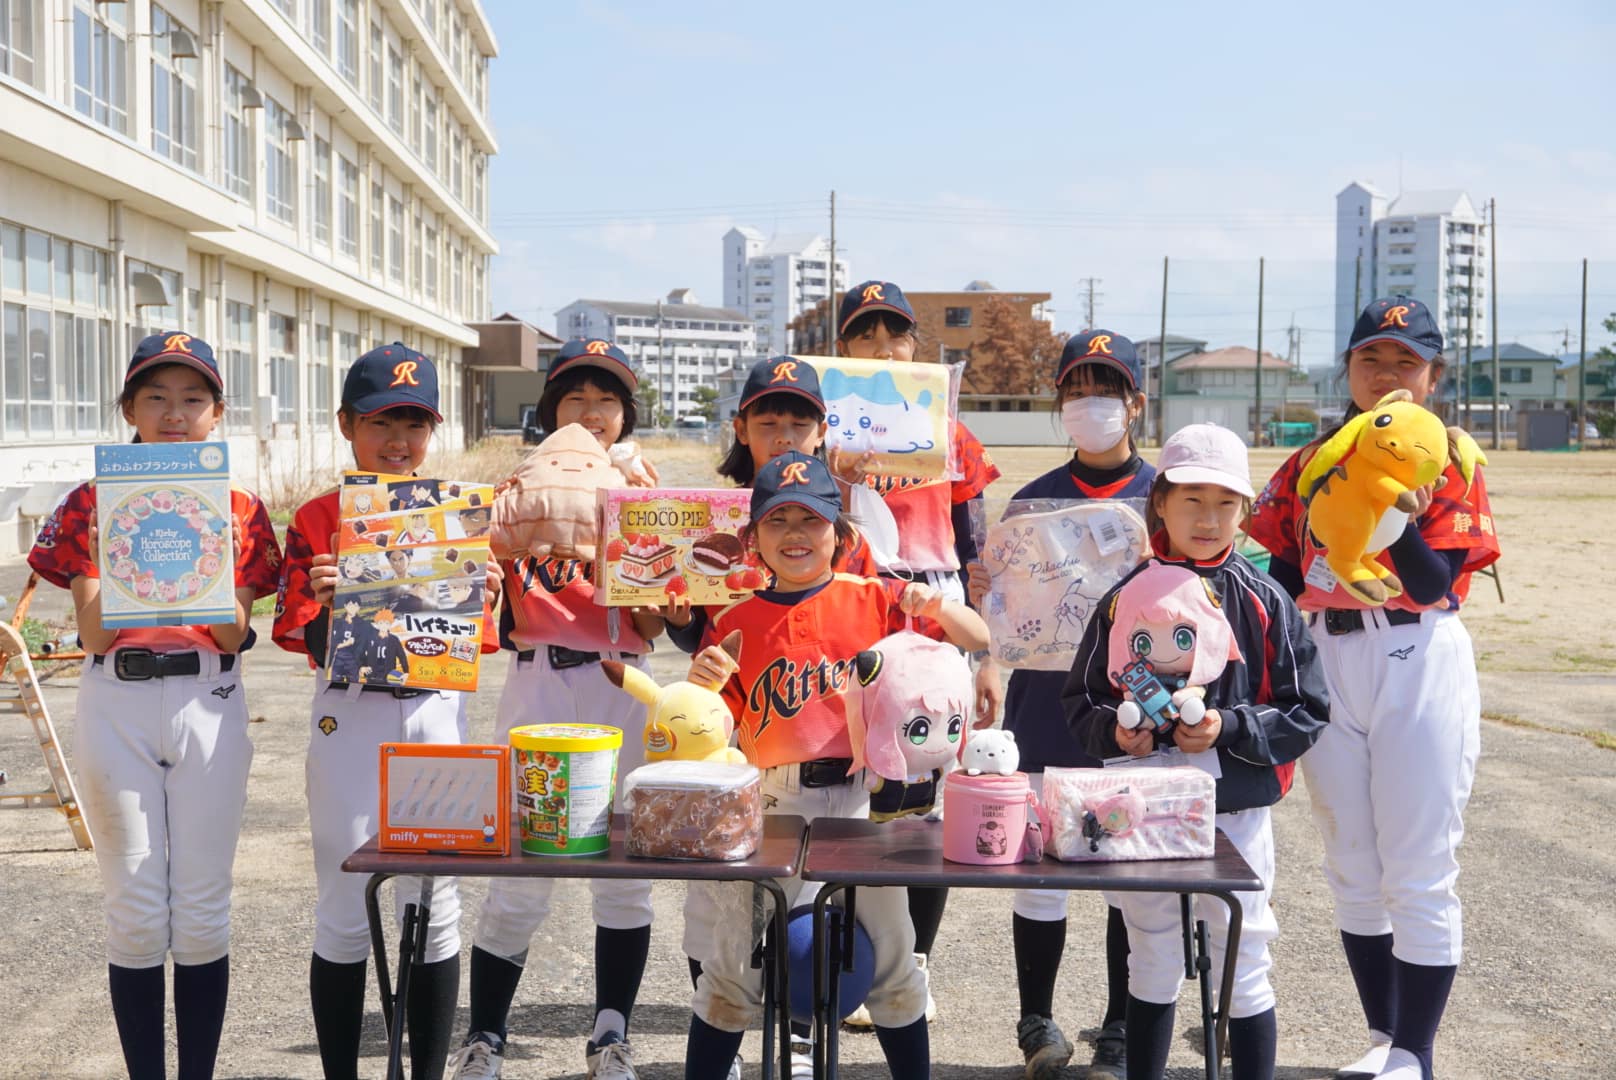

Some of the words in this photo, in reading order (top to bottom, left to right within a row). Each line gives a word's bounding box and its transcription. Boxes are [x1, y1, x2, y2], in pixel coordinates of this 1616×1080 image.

[863, 284, 885, 304] R
[1377, 305, 1408, 330] R
[161, 334, 192, 353] R
[585, 340, 609, 355] R
[1086, 335, 1112, 356] R
[389, 360, 419, 388] R
[768, 361, 798, 384] R
[778, 461, 810, 489] R
[626, 510, 679, 526] CHOCO
[681, 511, 705, 526] PIE
[141, 536, 192, 551] Horoscope
[143, 549, 191, 562] Collection
[1028, 554, 1081, 578] Pikachu
[390, 832, 419, 844] miffy
